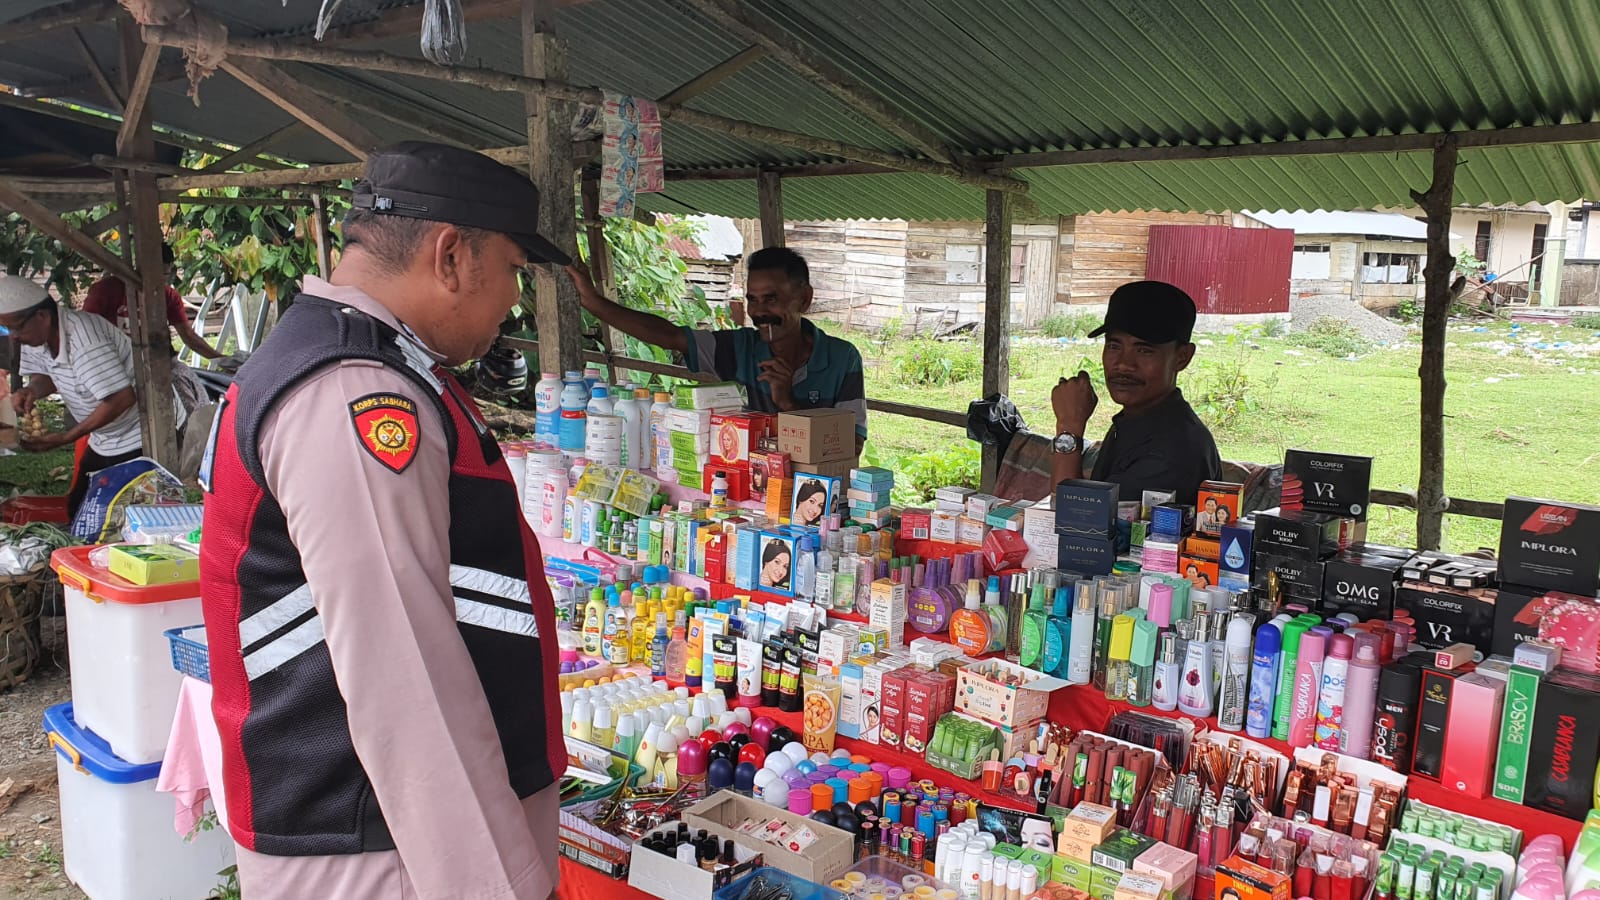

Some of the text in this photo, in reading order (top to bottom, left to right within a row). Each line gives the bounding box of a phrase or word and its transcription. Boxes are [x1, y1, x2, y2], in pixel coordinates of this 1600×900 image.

[352, 397, 411, 411] KORPS SABHARA
[1310, 459, 1344, 469] COLORFIX
[1313, 481, 1336, 499] VR
[1063, 494, 1102, 503] IMPLORA
[1272, 529, 1299, 539] DOLBY
[1065, 544, 1105, 553] IMPLORA
[1521, 540, 1577, 557] IMPLORA
[1275, 566, 1302, 576] DOLBY
[1336, 581, 1379, 600] OMG
[1423, 597, 1464, 611] COLORFIX
[1425, 621, 1454, 643] VR
[1323, 674, 1345, 689] pos
[1507, 689, 1529, 745] BRASOV
[1374, 717, 1394, 760] posh
[1551, 714, 1577, 783] CASABLANCA
